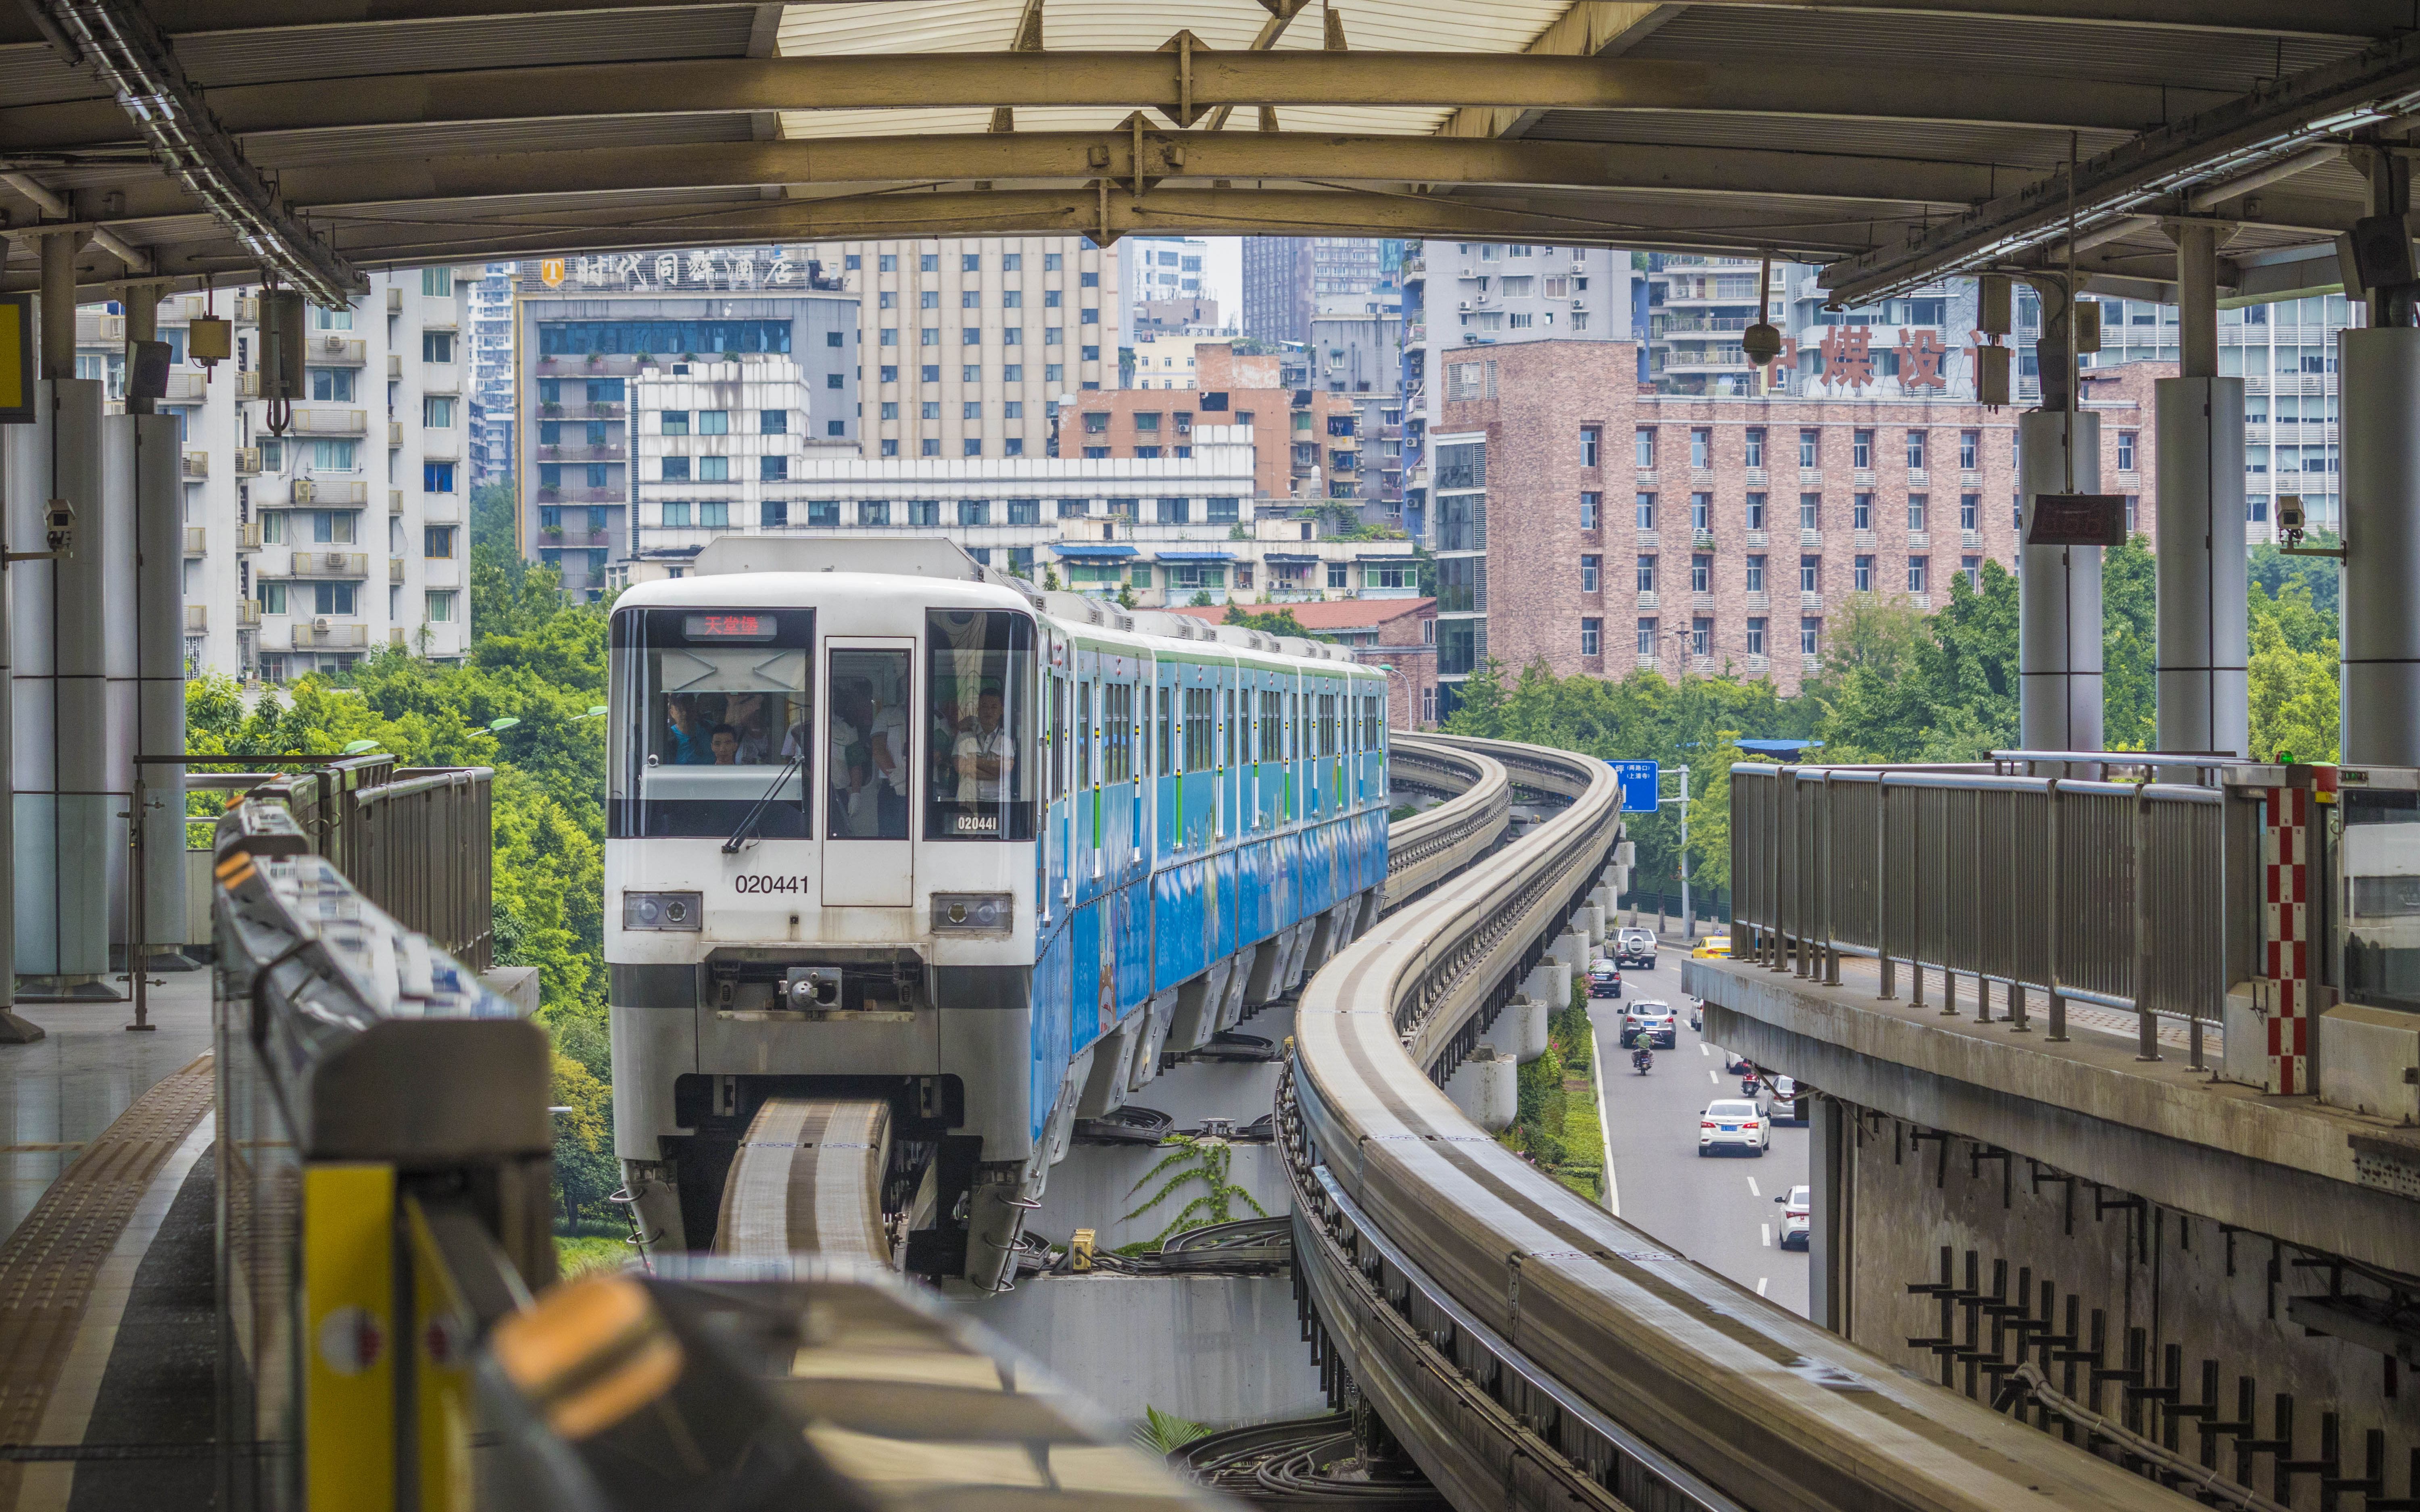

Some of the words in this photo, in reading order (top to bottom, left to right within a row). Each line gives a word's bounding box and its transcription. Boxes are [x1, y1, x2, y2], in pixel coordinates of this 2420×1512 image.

[576, 252, 795, 287] 时代同辉酒店
[705, 616, 757, 635] 天堂堡
[958, 816, 997, 831] 020441
[735, 875, 808, 894] 020441
